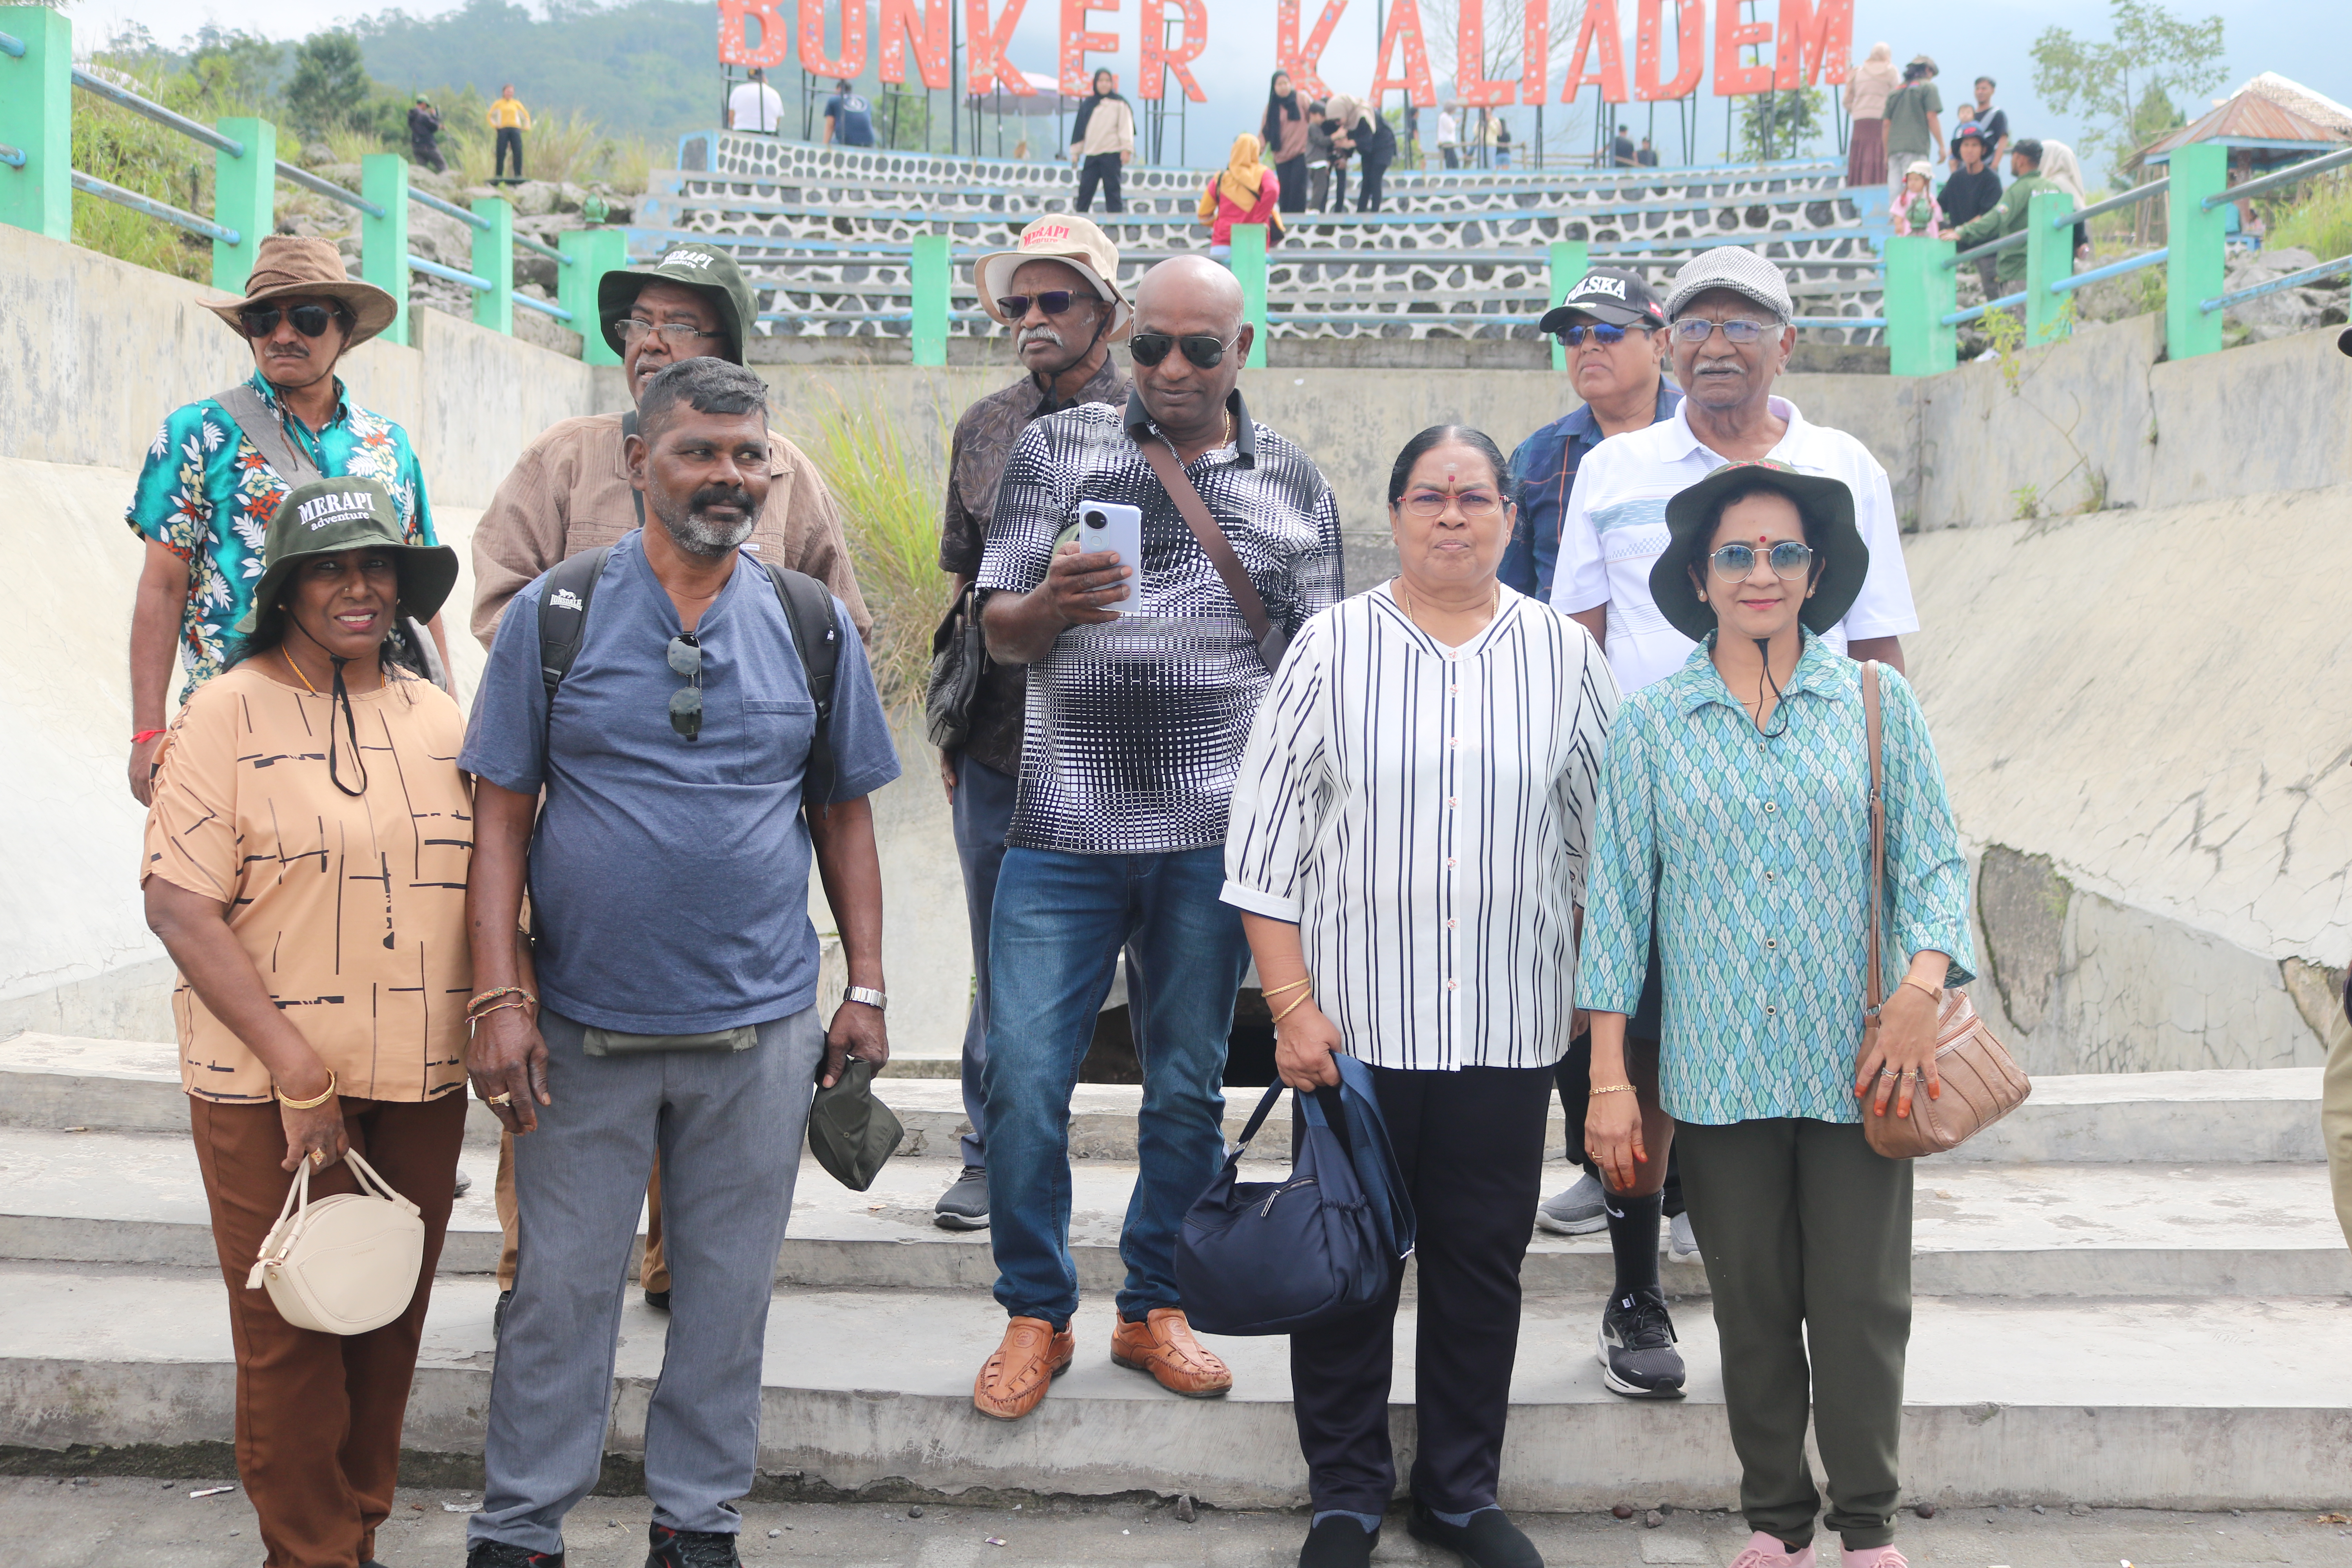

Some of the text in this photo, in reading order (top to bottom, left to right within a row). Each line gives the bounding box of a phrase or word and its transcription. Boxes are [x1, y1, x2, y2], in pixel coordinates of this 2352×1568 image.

[718, 0, 1855, 107] BUNKER KALIADEM
[297, 492, 376, 525] MERAPI
[311, 512, 370, 531] adventure
[549, 594, 583, 612] LONSDALE
